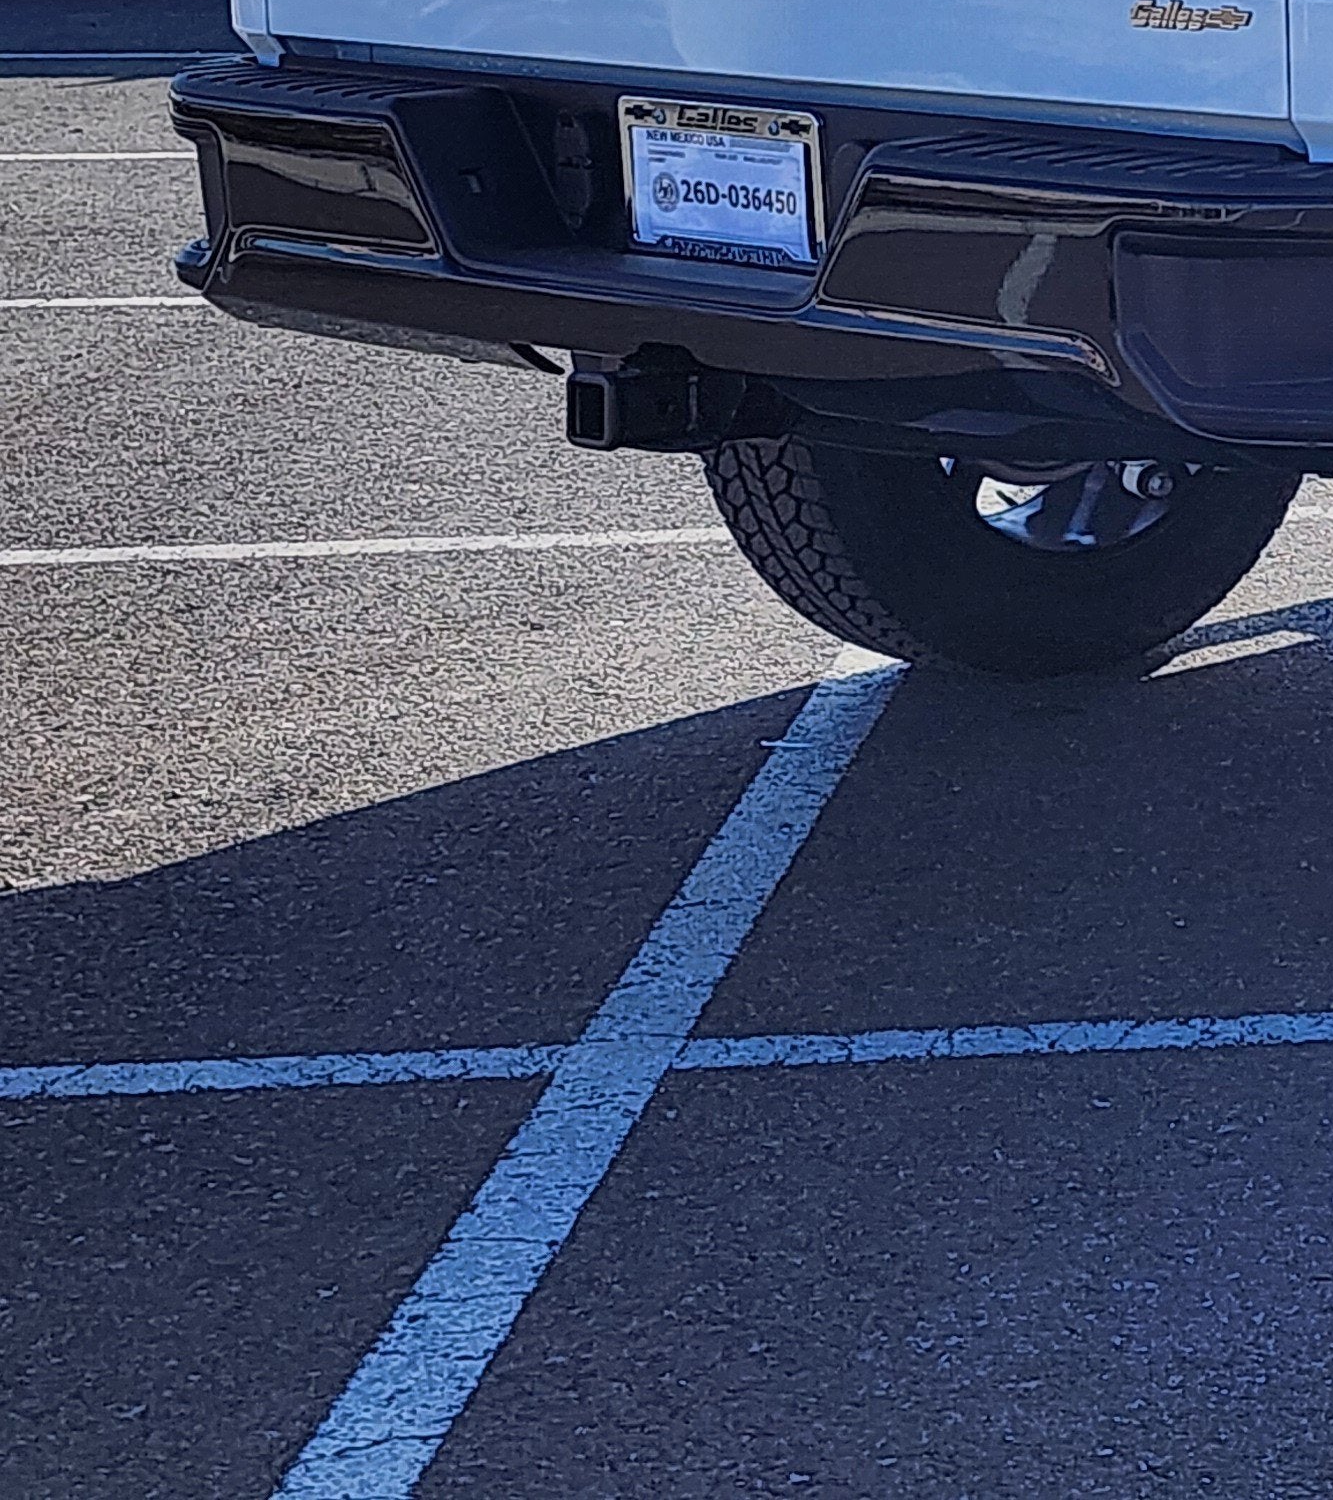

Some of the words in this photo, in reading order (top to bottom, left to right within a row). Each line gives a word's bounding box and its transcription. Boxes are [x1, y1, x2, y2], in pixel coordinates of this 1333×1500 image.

[645, 129, 668, 141] NEW
[670, 131, 705, 146] MEXICO
[706, 134, 727, 148] USA
[680, 179, 797, 215] 26D-036450
